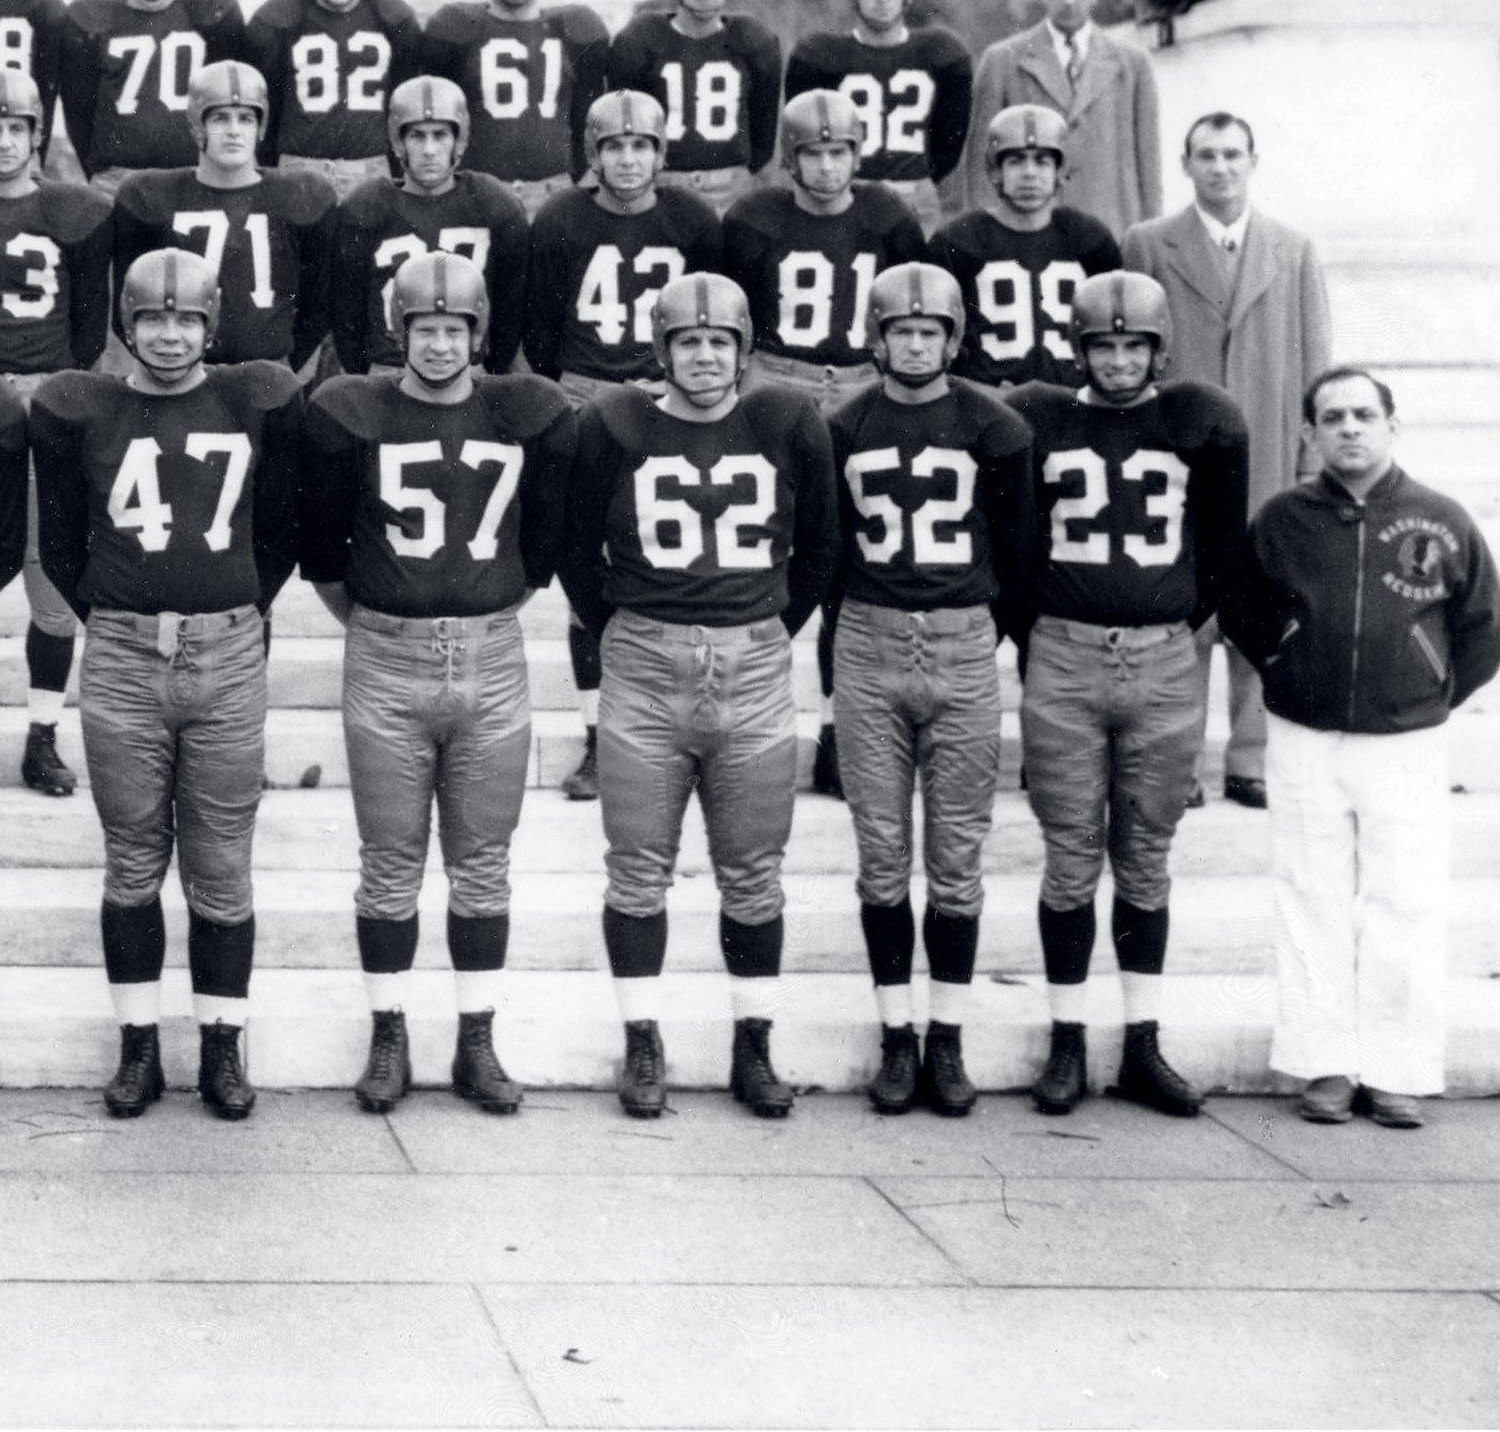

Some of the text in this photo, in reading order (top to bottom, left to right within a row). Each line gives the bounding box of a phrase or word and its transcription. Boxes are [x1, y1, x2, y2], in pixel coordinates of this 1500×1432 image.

[109, 31, 205, 114] 70
[292, 31, 392, 113] 82
[479, 38, 563, 119] 61
[661, 60, 741, 141] 18
[172, 210, 275, 308] 71
[576, 244, 686, 345] 42
[777, 250, 877, 349] 81
[976, 260, 1087, 361] 99
[107, 432, 253, 553] 47
[379, 440, 524, 561] 57
[633, 453, 778, 569] 62
[845, 446, 979, 565] 52
[1043, 448, 1191, 567] 23
[1378, 517, 1460, 554] WASHINGTON
